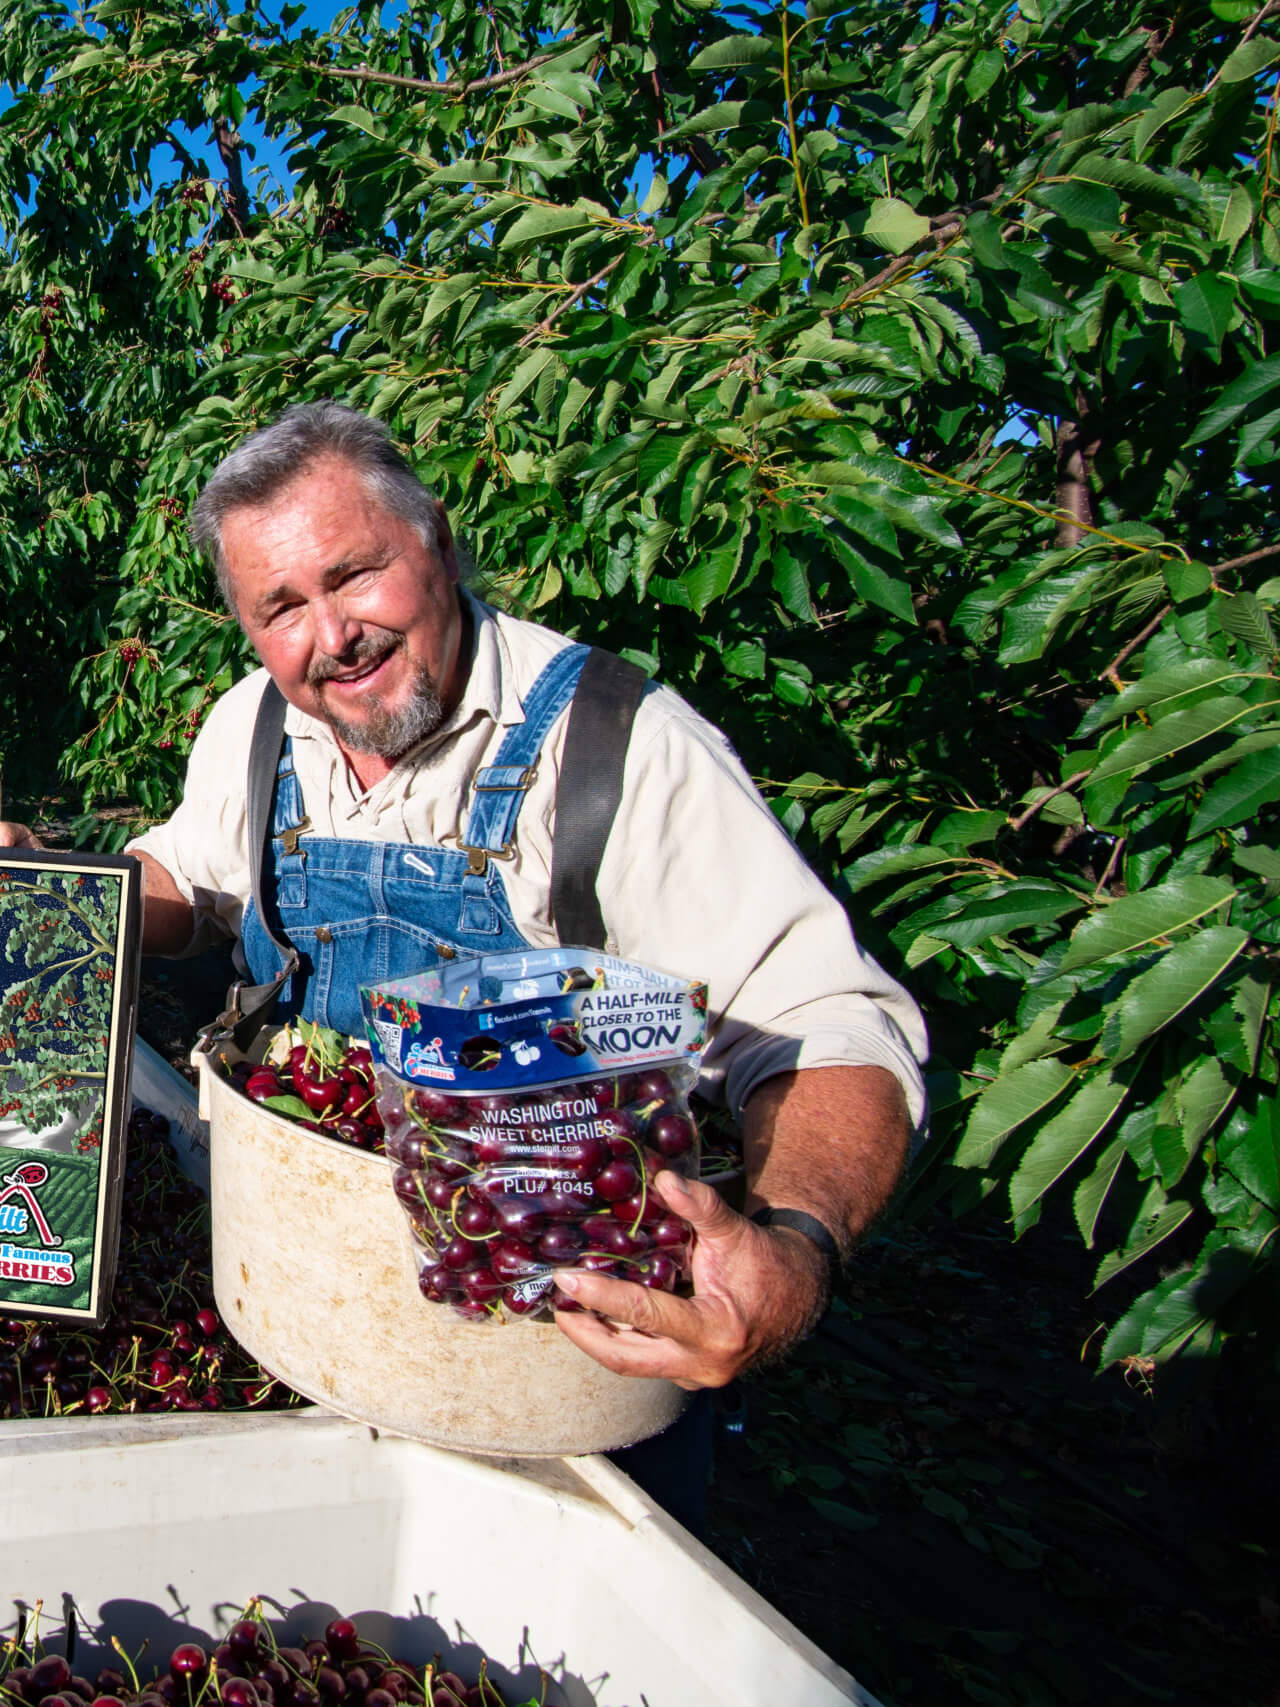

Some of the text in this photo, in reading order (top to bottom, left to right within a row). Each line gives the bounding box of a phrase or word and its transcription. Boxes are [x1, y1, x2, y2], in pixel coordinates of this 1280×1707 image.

[580, 992, 686, 1011] A HALF-MILE
[583, 1008, 682, 1028] CLOSER TO THE
[582, 1025, 682, 1055] MOON
[481, 1097, 598, 1125] WASHINGTON
[469, 1119, 614, 1143] SWEET CHERRIES
[503, 1179, 593, 1196] PLU# 4045
[3, 1244, 71, 1264] Famous
